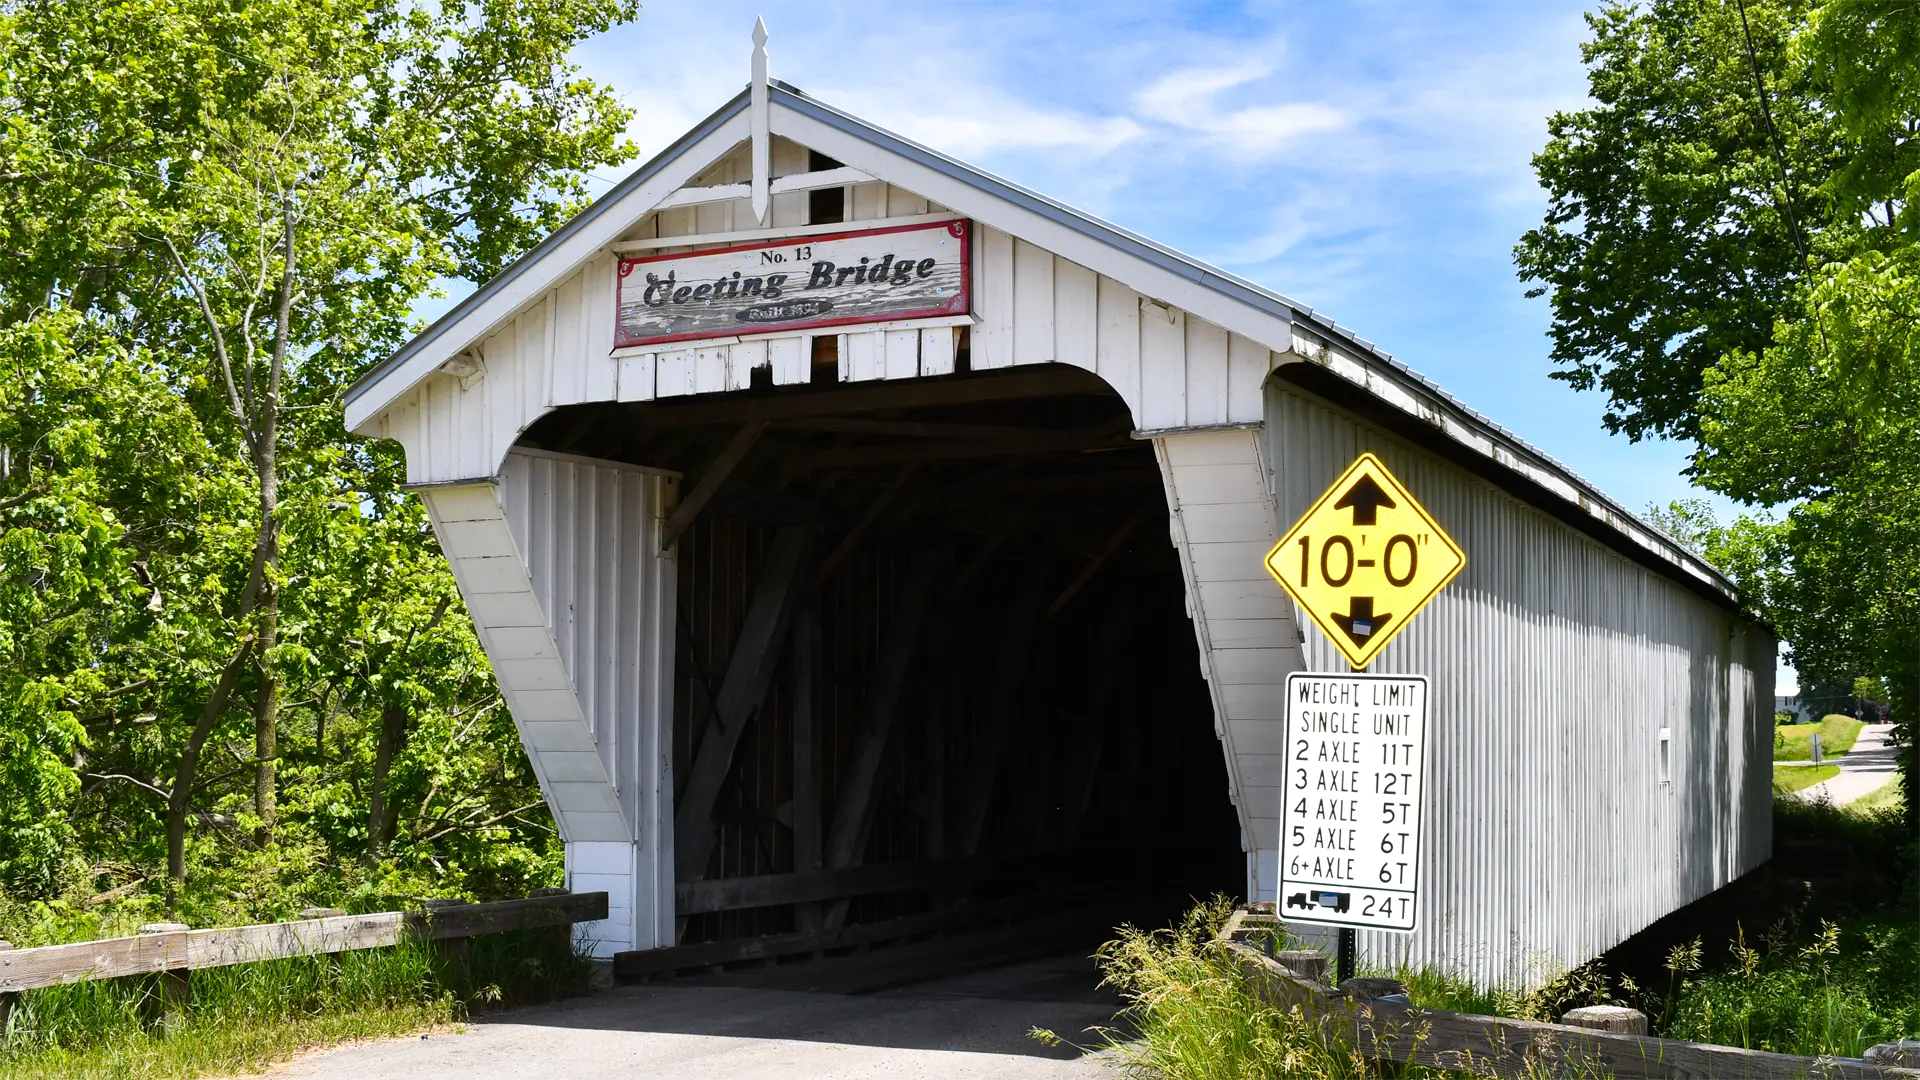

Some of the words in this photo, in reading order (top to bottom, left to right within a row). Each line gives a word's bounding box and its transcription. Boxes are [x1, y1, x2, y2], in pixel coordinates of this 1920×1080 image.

[760, 251, 788, 265] No.
[794, 246, 812, 261] 13
[804, 254, 935, 290] Bridge
[1299, 682, 1359, 704] WEIGHT
[1373, 684, 1417, 706] LIMIT
[1301, 711, 1360, 734] SINGLE
[1374, 714, 1410, 736] UNIT
[1296, 740, 1308, 760] 2
[1318, 741, 1360, 763] AXLE
[1382, 743, 1413, 765] 11T
[1295, 768, 1307, 789] 3
[1317, 769, 1359, 792] AXLE
[1375, 772, 1412, 795] 12T
[1294, 797, 1307, 818] 4
[1316, 798, 1358, 821] AXLE
[1382, 802, 1410, 824] 5T
[1292, 826, 1304, 847] 5
[1314, 827, 1356, 850] AXLE
[1381, 833, 1409, 854] 6T
[1380, 862, 1407, 884] 6T
[1362, 895, 1409, 919] 24T
